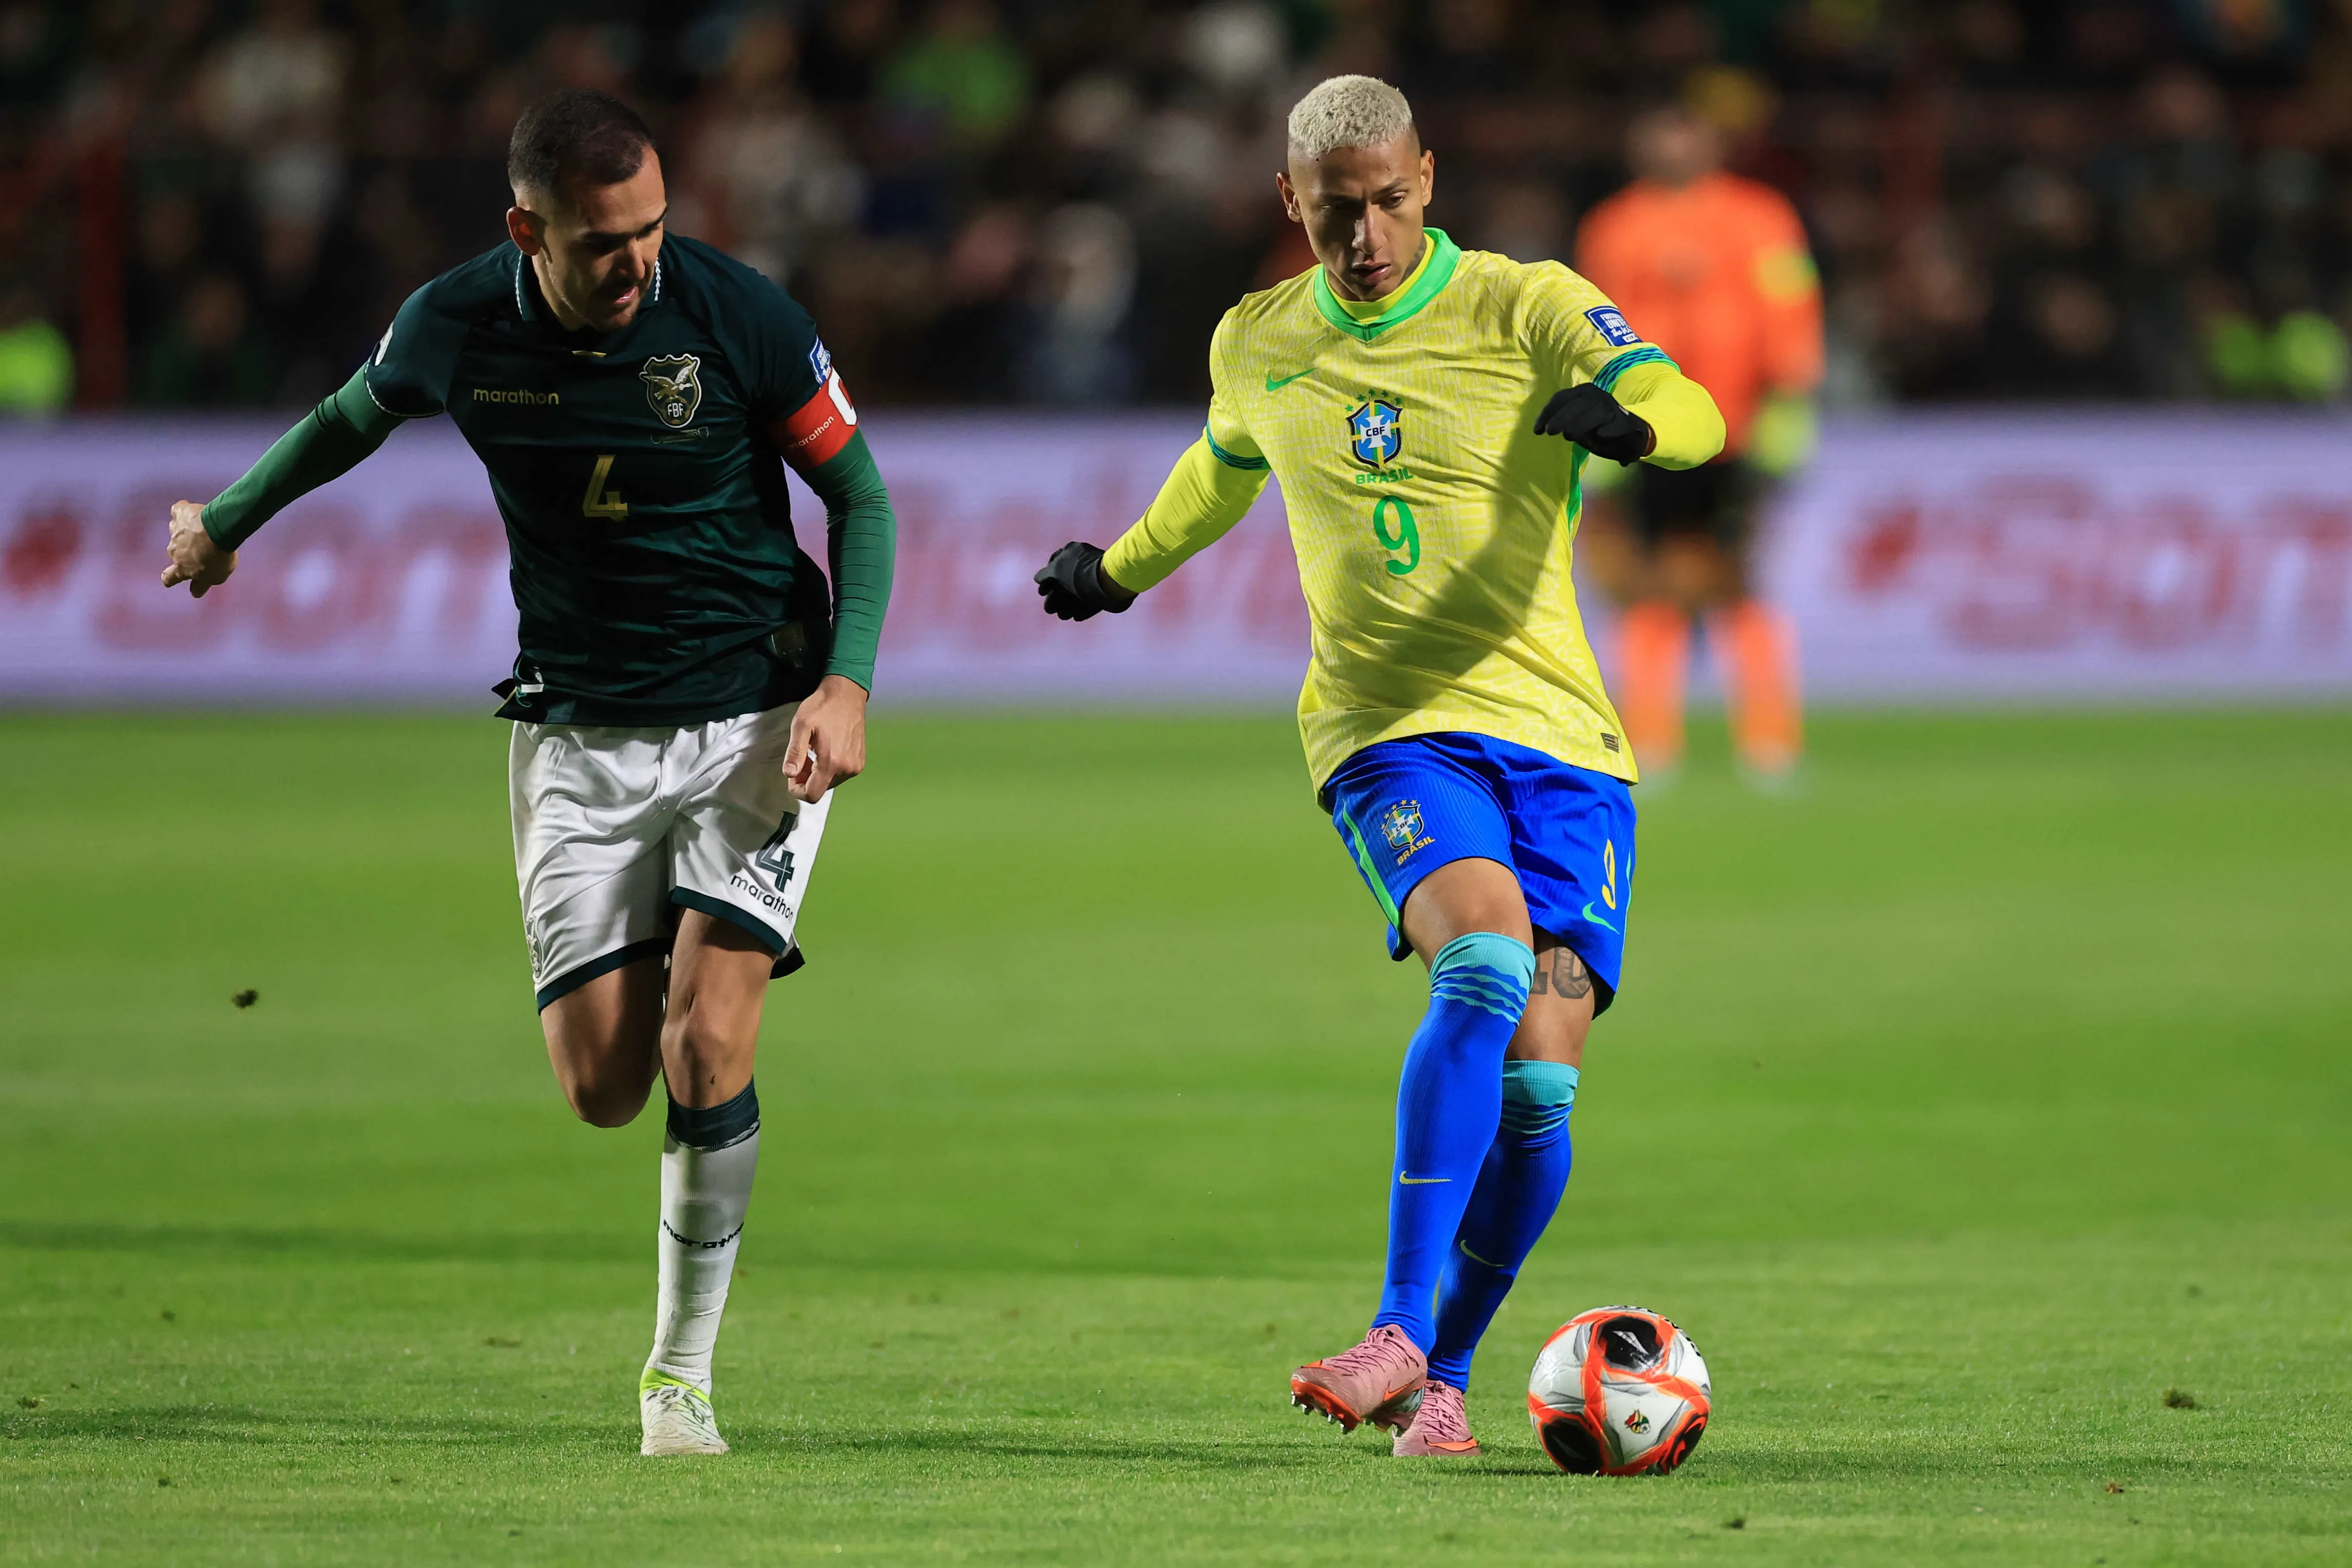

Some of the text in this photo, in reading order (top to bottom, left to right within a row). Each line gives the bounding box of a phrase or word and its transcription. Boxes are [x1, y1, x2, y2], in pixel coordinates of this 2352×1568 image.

[474, 388, 559, 405] marathon
[668, 403, 684, 417] FBF
[1366, 426, 1385, 437] CBF
[582, 454, 628, 521] 4
[1356, 467, 1413, 485] BRASIL
[1373, 495, 1420, 575] 9
[1396, 820, 1409, 832] CBF
[754, 811, 797, 893] 4
[1397, 836, 1435, 865] BRASIL
[1601, 839, 1616, 910] 9
[730, 875, 793, 924] marathon
